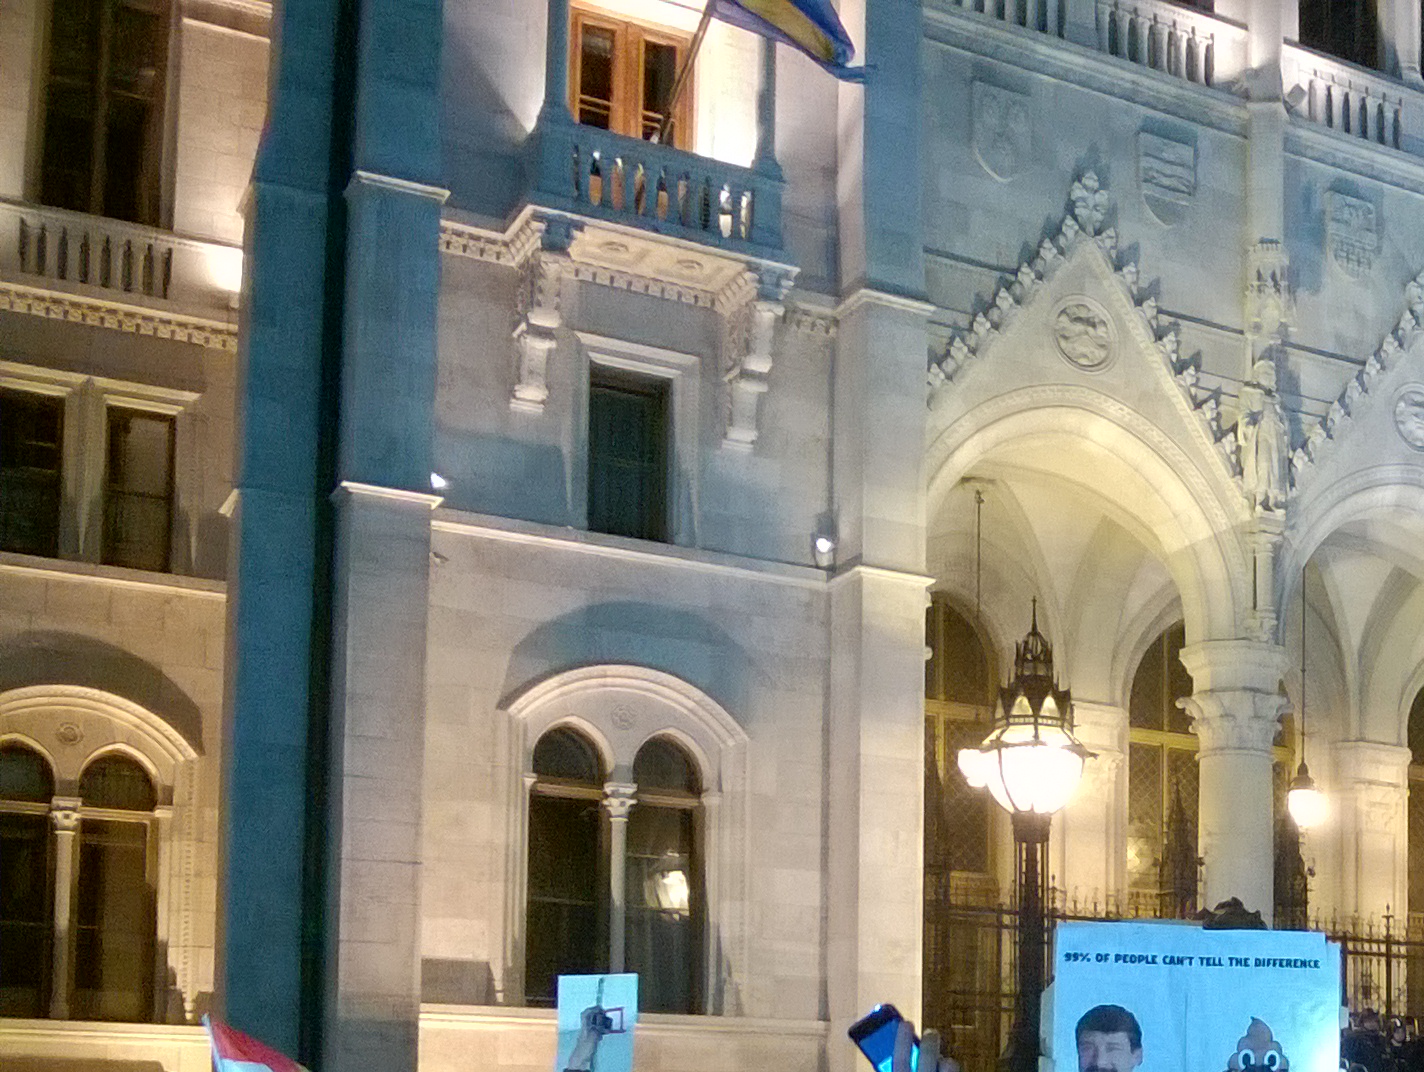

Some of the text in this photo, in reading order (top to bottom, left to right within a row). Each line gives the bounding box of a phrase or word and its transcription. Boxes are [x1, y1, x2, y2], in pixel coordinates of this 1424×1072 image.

[1064, 952, 1320, 969] 99% OF PEOPLE CAN'T TELL THE DIFFERENCE
